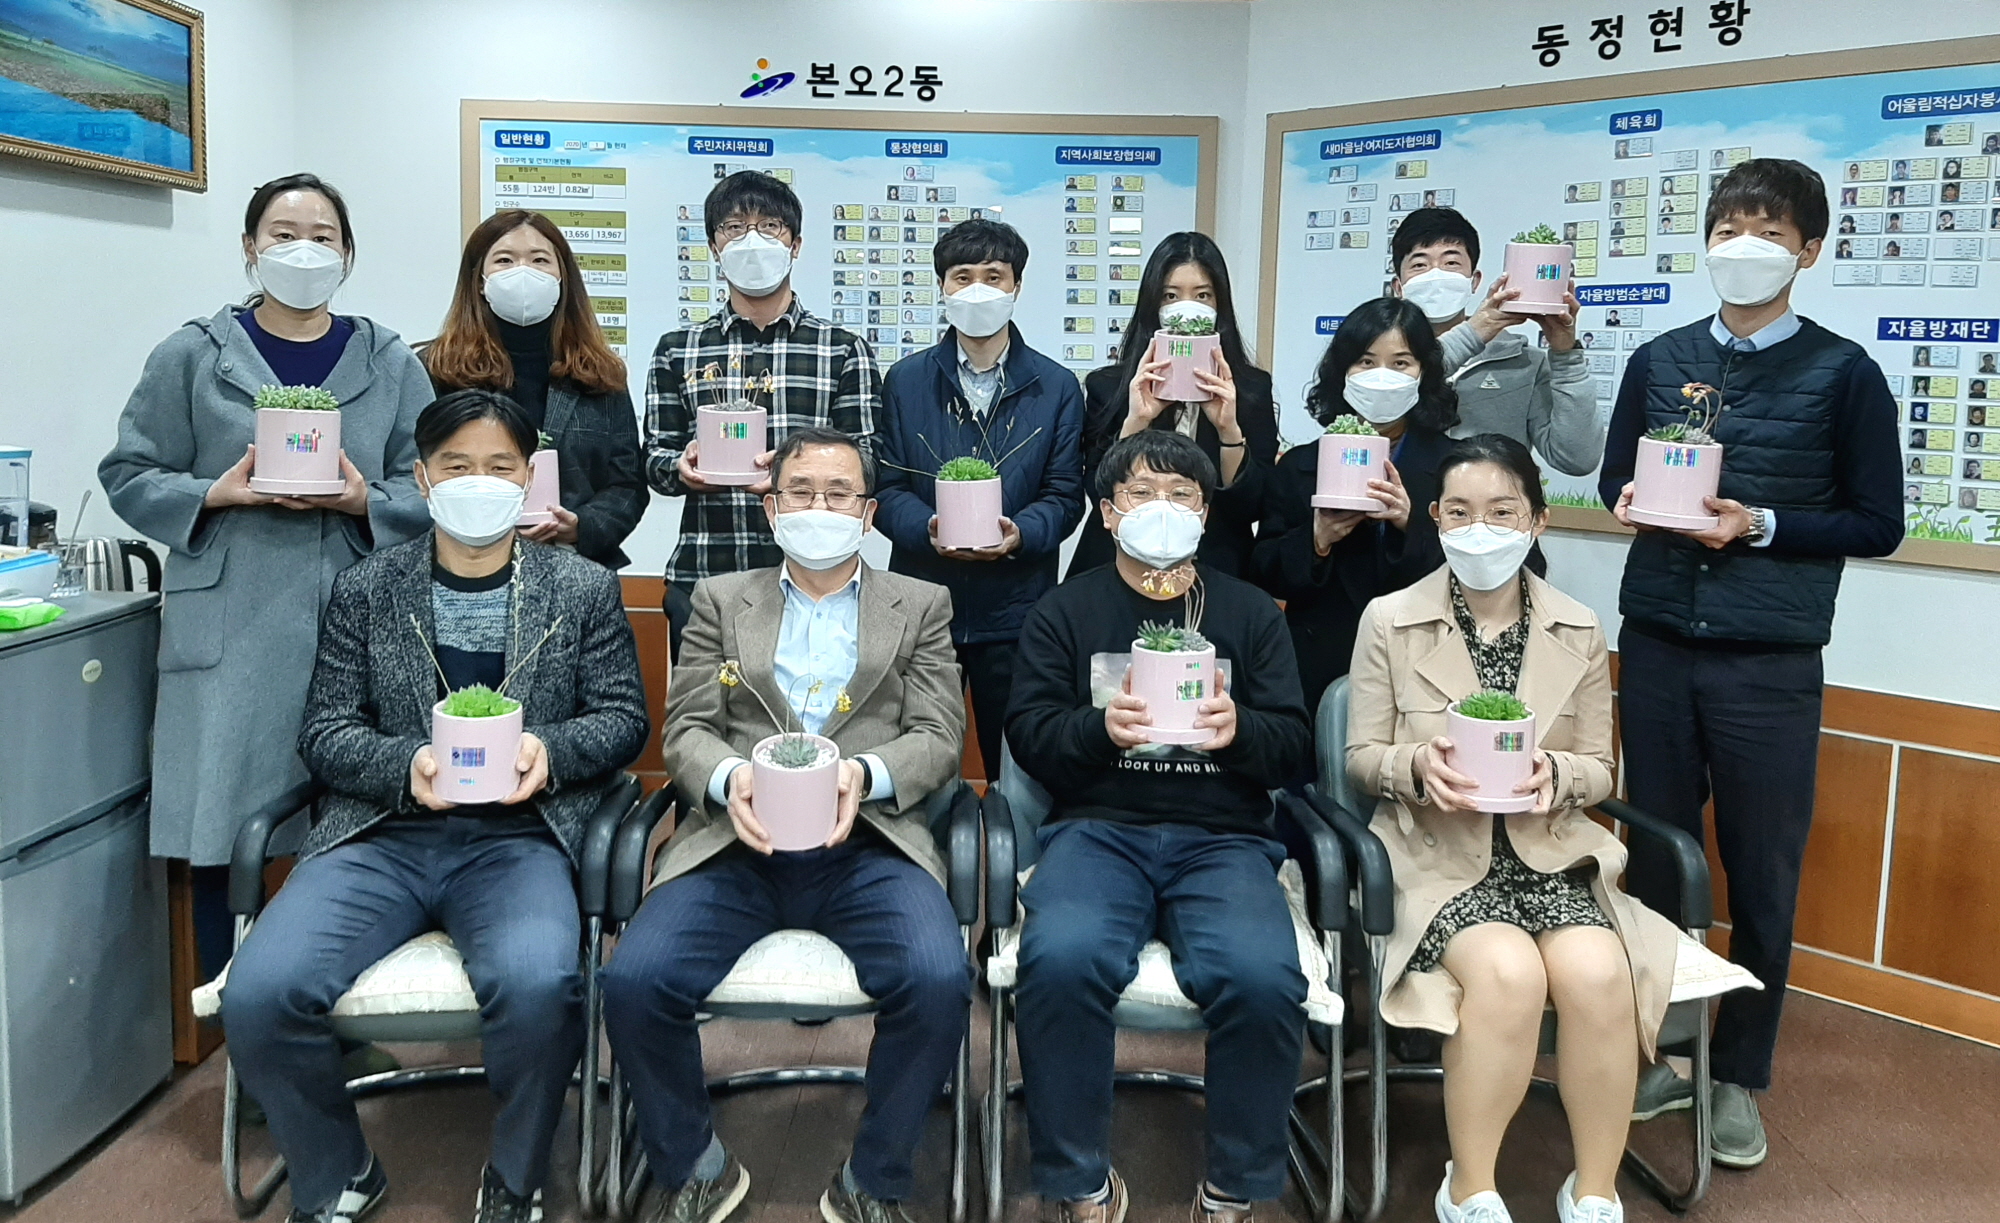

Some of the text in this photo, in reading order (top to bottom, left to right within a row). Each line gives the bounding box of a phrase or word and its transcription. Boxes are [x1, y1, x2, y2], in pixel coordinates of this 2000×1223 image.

[1531, 0, 1751, 68] 동정현황
[806, 62, 943, 102] 본오2동
[1615, 113, 1658, 131] 체육회
[500, 133, 546, 147] 일반현황
[693, 139, 768, 154] 주민자치위원회
[890, 142, 944, 155] 통장협의회
[1060, 148, 1156, 162] 지역사회보장협의체
[533, 184, 556, 194] 124반
[564, 230, 590, 239] 13,656
[596, 230, 622, 239] 13,967
[1579, 287, 1667, 302] 자율방범순찰대
[602, 316, 620, 326] 18명
[1320, 319, 1344, 332] 바르
[1887, 319, 1991, 339] 자율방재단
[1118, 759, 1150, 772] LOOK
[1155, 762, 1171, 772] UP
[1175, 763, 1201, 773] AND
